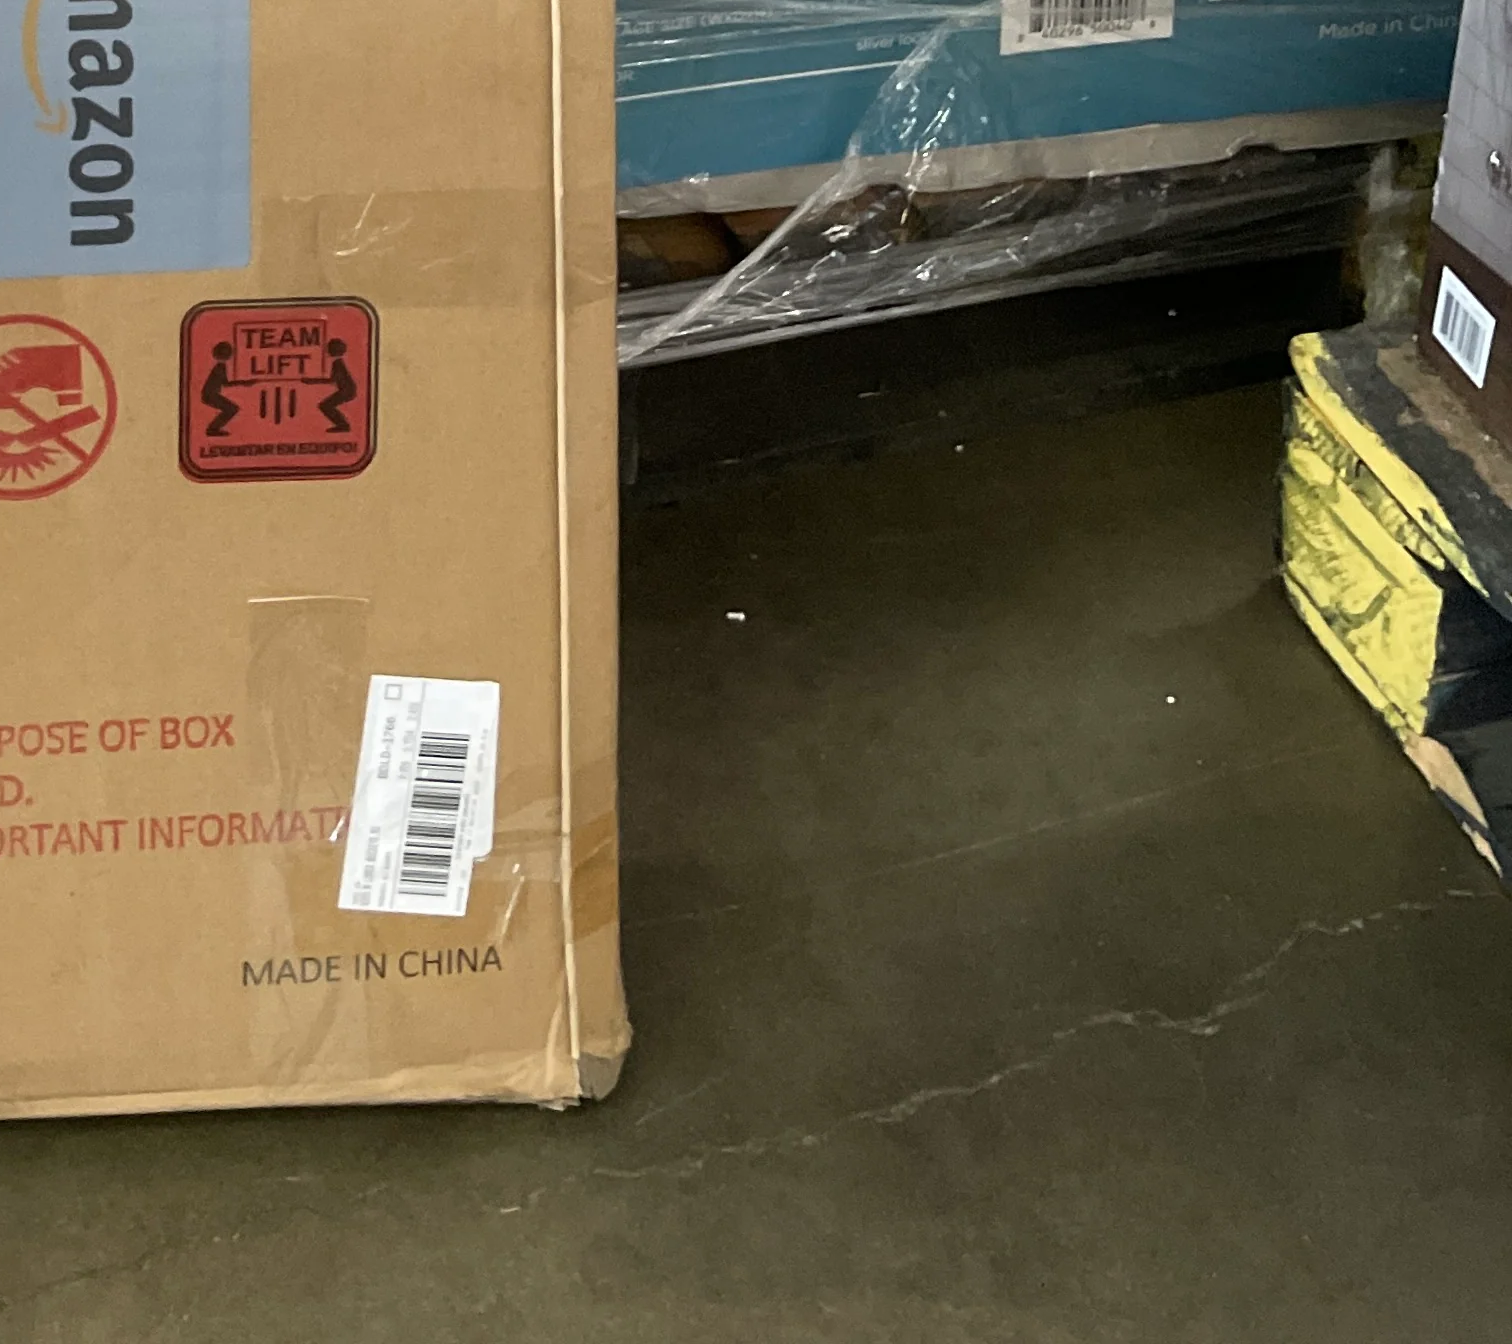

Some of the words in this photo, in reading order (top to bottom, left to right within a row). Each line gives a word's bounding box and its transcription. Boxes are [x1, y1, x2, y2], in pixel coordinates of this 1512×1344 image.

[1318, 21, 1377, 40] Made
[1384, 18, 1403, 32] in
[241, 326, 320, 349] TEAM
[251, 354, 312, 376] LIFT
[98, 718, 148, 753] OF
[159, 714, 236, 750] BOX
[241, 955, 342, 987] MADE
[354, 953, 386, 980] IN
[398, 944, 502, 978] CHINA
